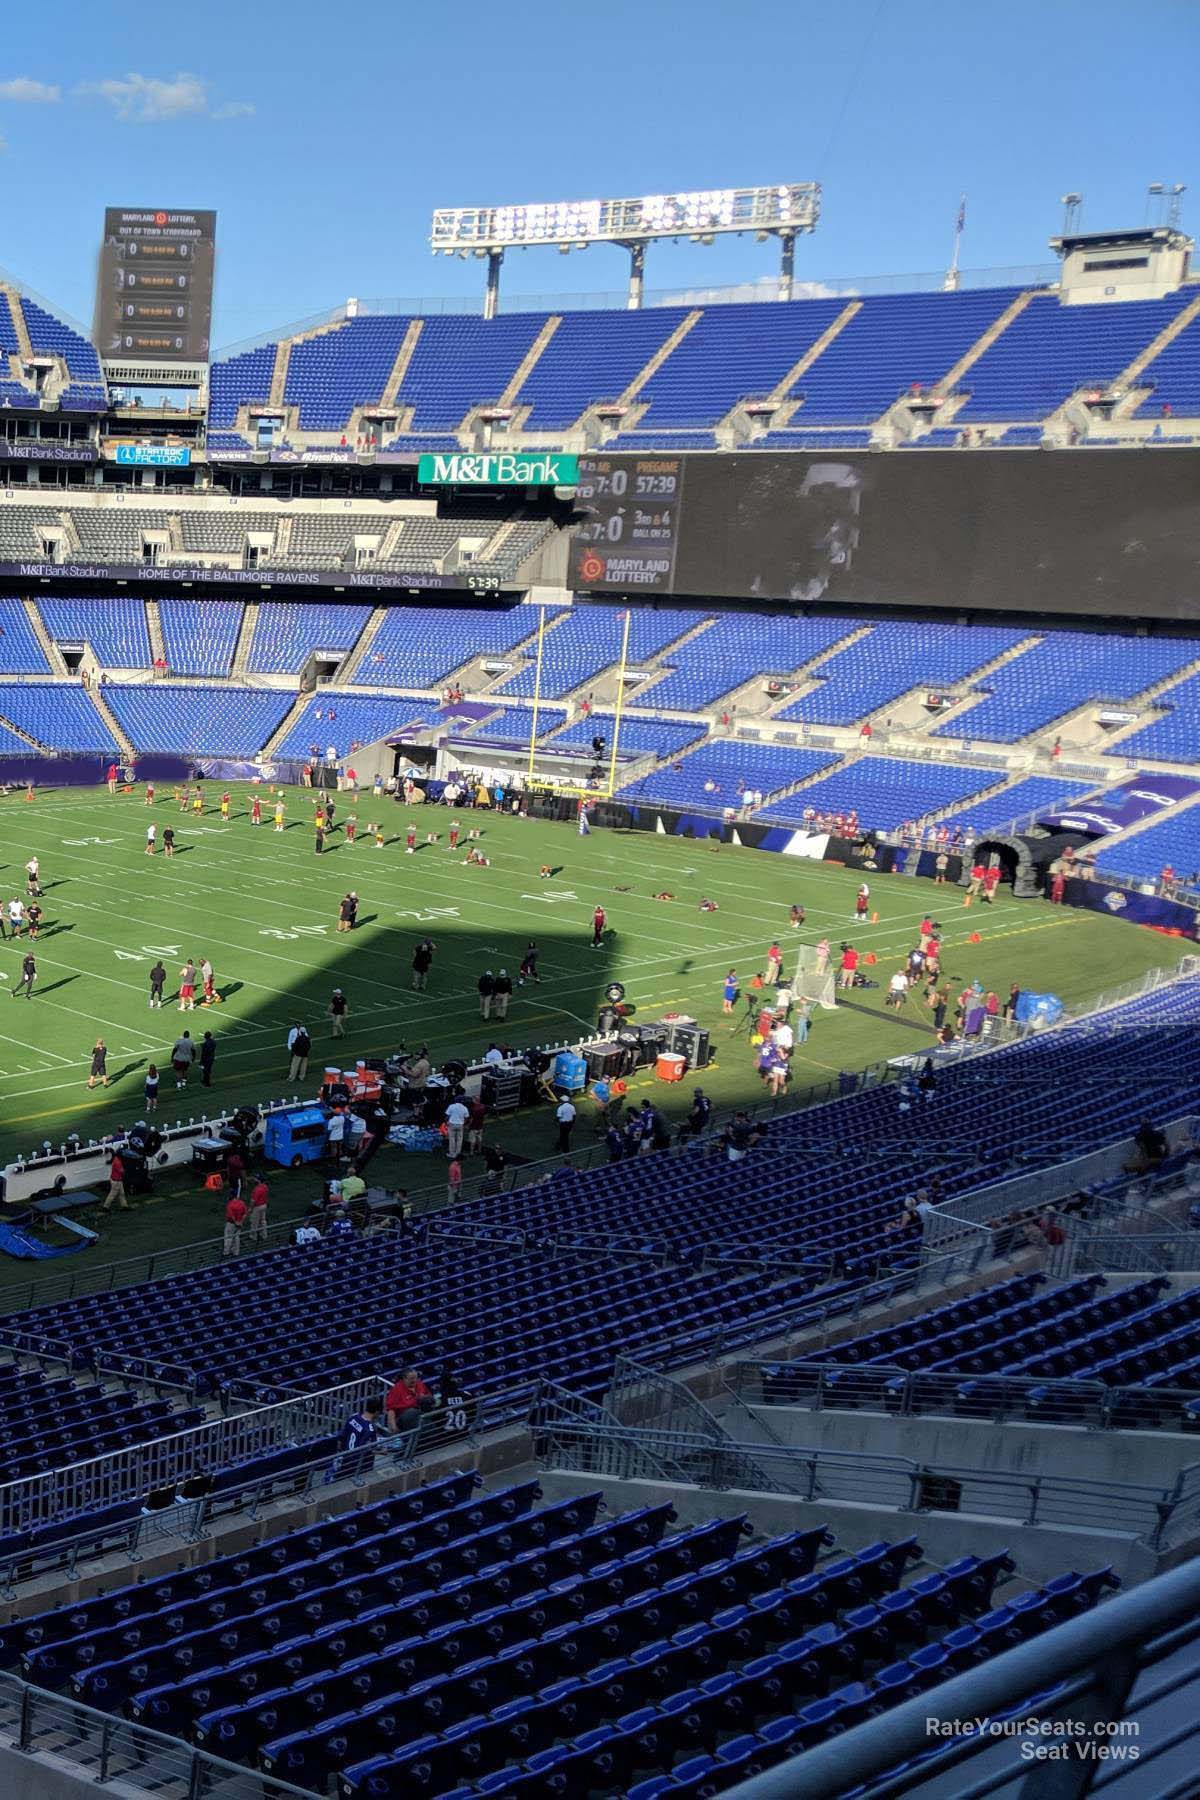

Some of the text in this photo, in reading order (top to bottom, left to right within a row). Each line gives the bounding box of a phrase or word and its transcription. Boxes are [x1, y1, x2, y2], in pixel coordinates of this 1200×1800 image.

[129, 242, 137, 255] 0
[180, 244, 187, 256] 0
[128, 273, 135, 286] 0
[178, 275, 186, 287] 0
[127, 304, 134, 316] 0
[177, 306, 184, 318] 0
[125, 336, 133, 347] 0
[7, 446, 92, 461] M&T Bank Stadium
[135, 455, 184, 464] FACTORY
[432, 455, 498, 482] M&T
[498, 455, 560, 483] Bank
[636, 475, 676, 494] 57:39
[20, 564, 108, 578] M&T Bank Stadium
[607, 558, 669, 573] MARYLAND
[138, 568, 319, 584] HOME OF THE BALTIMORE RAVENS
[350, 574, 442, 588] M&T Bank Stadium
[467, 576, 499, 589] 57:39
[605, 571, 656, 584] LOTTERY
[395, 907, 460, 921] 20
[258, 925, 328, 940] 30
[113, 945, 179, 961] 40
[673, 1065, 683, 1076] G
[444, 1409, 467, 1431] 20
